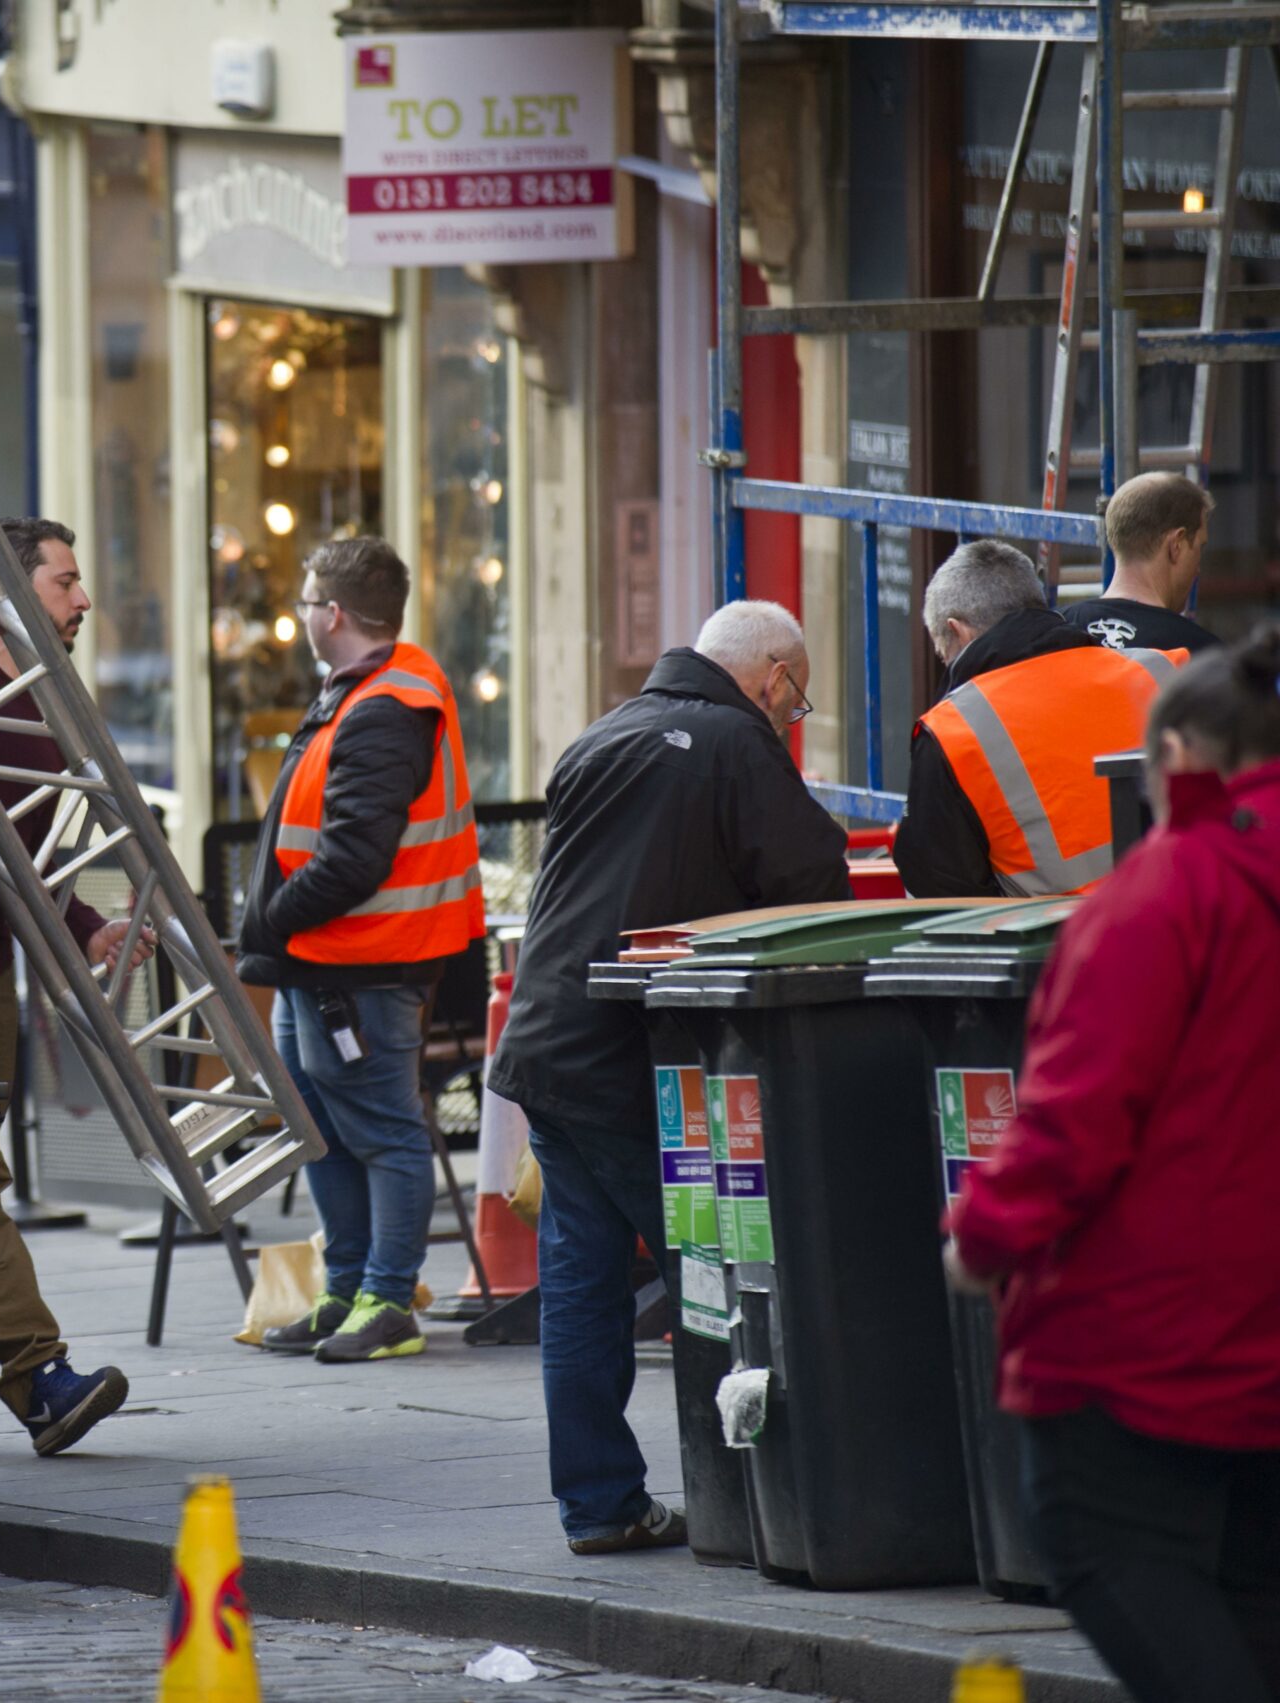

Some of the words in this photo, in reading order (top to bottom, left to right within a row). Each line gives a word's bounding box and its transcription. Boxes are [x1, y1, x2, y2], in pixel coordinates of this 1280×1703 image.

[387, 97, 463, 141] TO
[480, 93, 580, 139] LET
[381, 149, 429, 166] WITH
[433, 147, 498, 166] DIRECT
[503, 143, 590, 163] LETTINGS
[373, 177, 449, 210] 0131
[455, 174, 514, 207] 202
